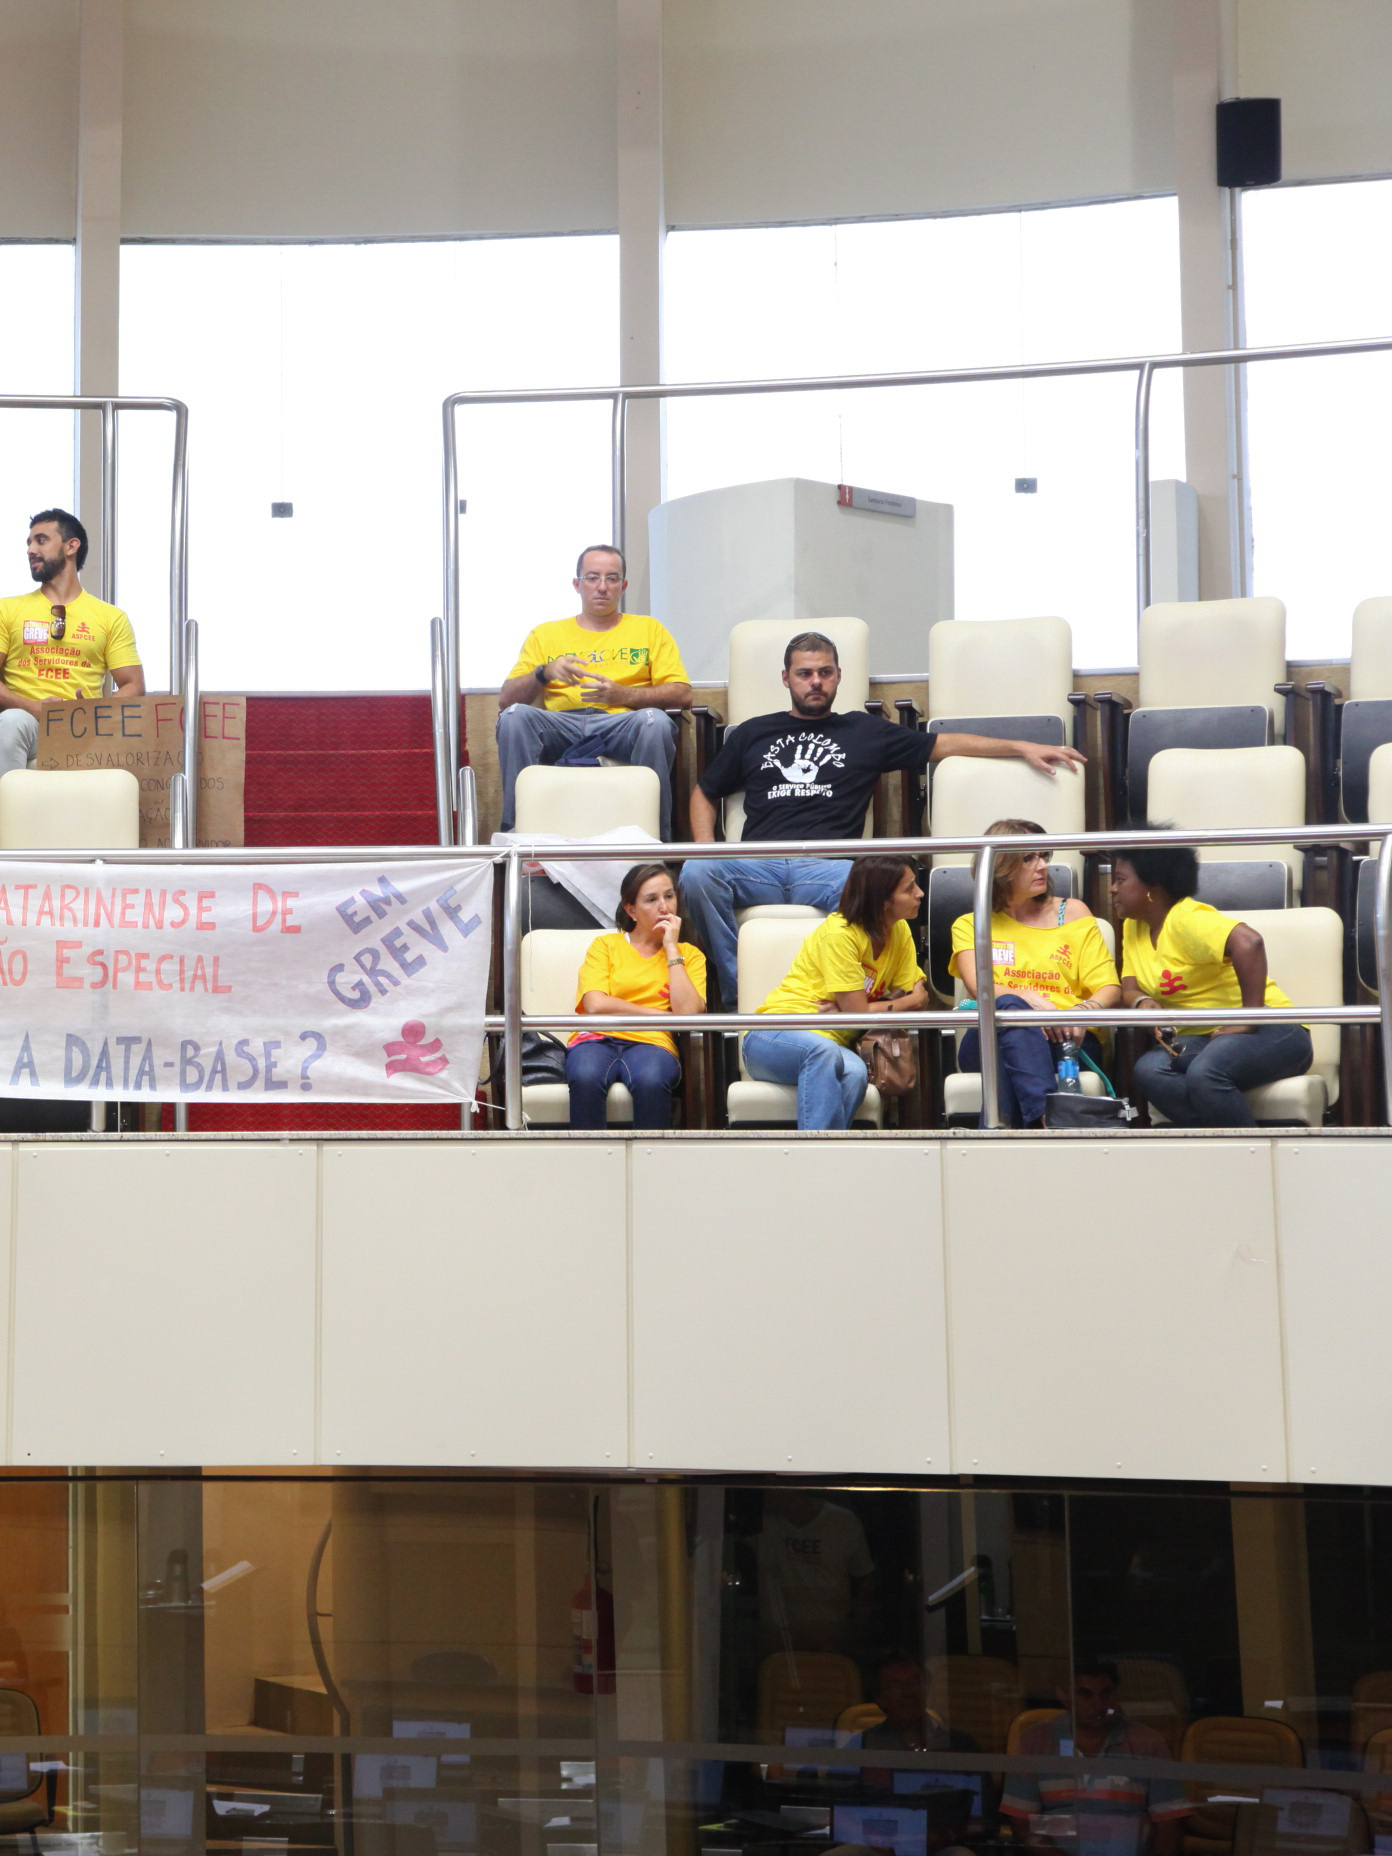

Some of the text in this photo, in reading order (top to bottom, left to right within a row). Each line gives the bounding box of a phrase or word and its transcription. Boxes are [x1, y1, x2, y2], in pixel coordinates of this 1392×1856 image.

[30, 646, 81, 657] Associação
[33, 657, 79, 667] Servidores
[38, 668, 70, 680] FCEE
[46, 702, 241, 741] FCEE FEE
[798, 732, 847, 768] COLOMBO
[767, 791, 791, 800] EXIGE
[252, 882, 303, 935] DE
[335, 874, 408, 936] EM
[326, 886, 483, 1011] GREVE
[56, 940, 233, 995] ESPECIAL
[1004, 967, 1061, 981] Associação
[9, 1048, 40, 1087] A
[64, 1030, 328, 1094] DATA-BASE?
